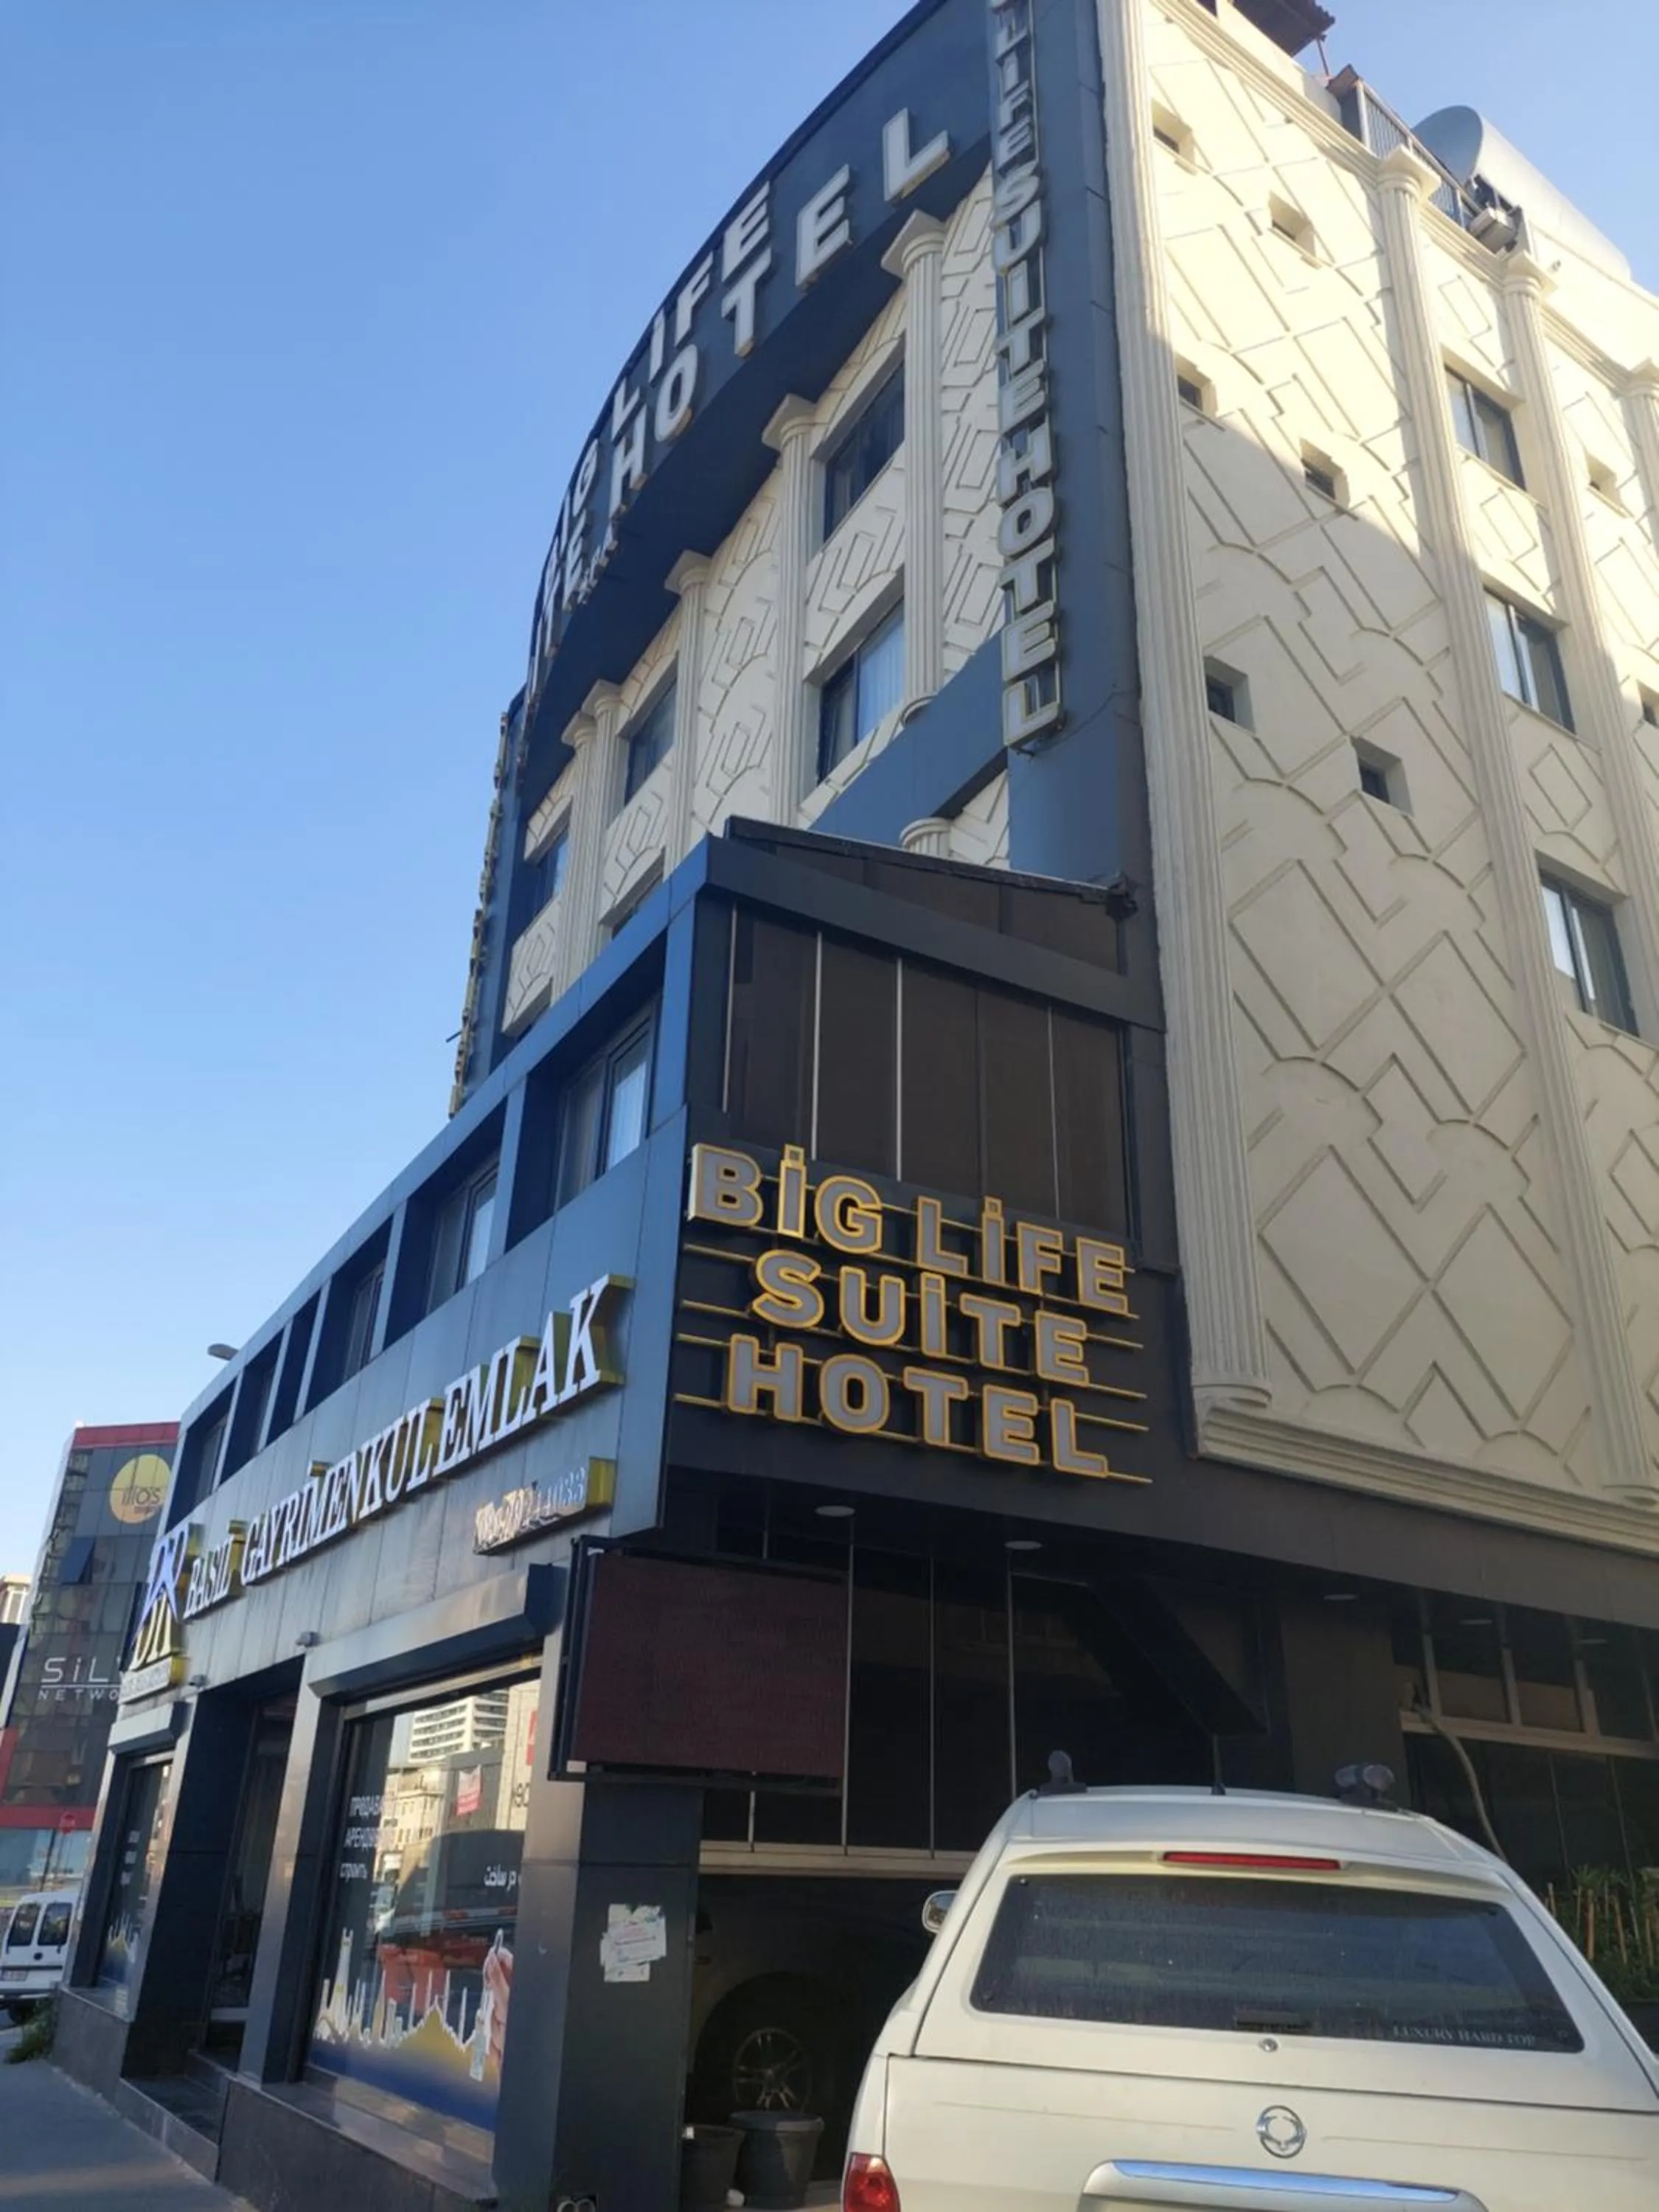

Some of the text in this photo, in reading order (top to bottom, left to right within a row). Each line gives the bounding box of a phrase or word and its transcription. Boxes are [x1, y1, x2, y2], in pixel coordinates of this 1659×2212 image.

[609, 107, 951, 521] HOTEL
[997, 422, 1062, 749] HOTEL
[432, 1274, 613, 1478] EMLAK
[726, 1333, 1109, 1478] HOTEL
